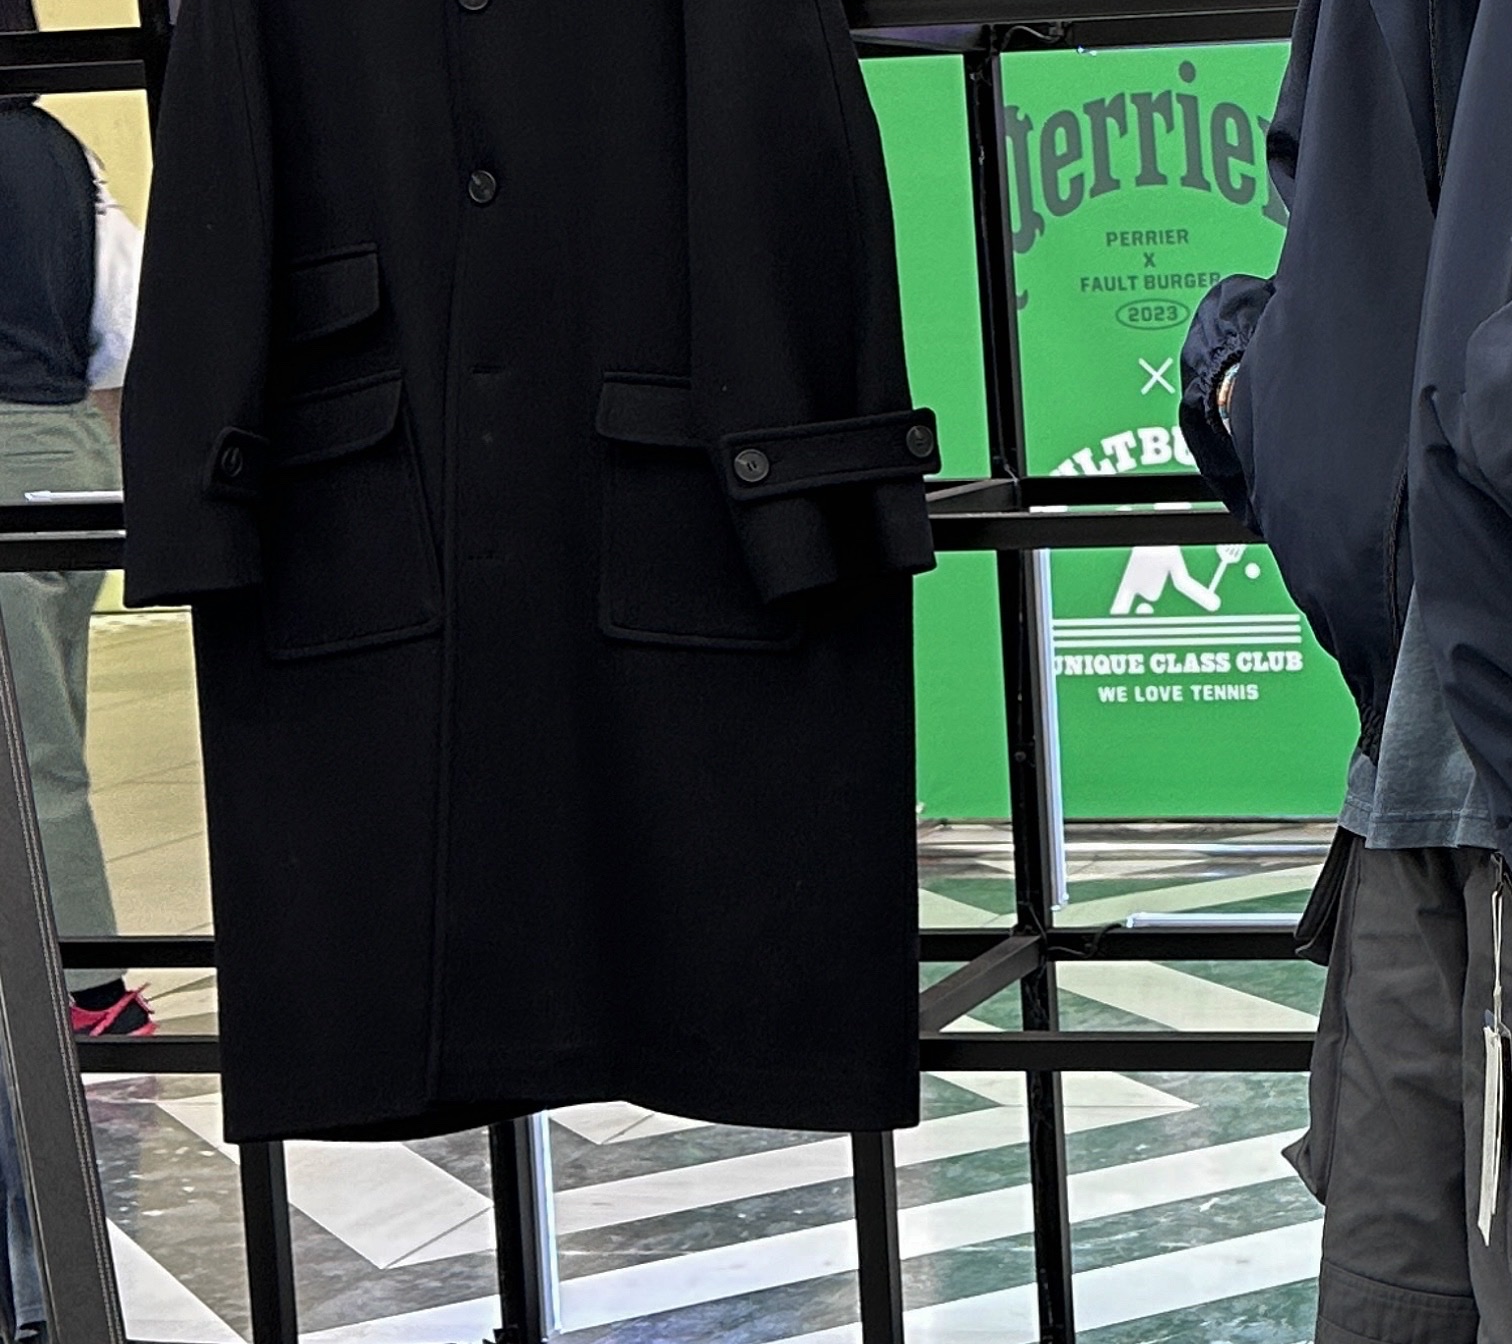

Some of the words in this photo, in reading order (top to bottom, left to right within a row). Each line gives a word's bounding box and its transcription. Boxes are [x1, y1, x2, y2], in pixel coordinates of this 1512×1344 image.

[1105, 229, 1189, 247] PERRIER
[1143, 252, 1156, 268] X
[1080, 275, 1138, 292] FAULT
[1128, 305, 1178, 322] 2023
[1150, 652, 1231, 674] CLASS
[1236, 650, 1304, 672] CLUB
[1098, 686, 1128, 703] WE
[1134, 685, 1183, 702] LOVE
[1190, 684, 1259, 701] TENNIS
